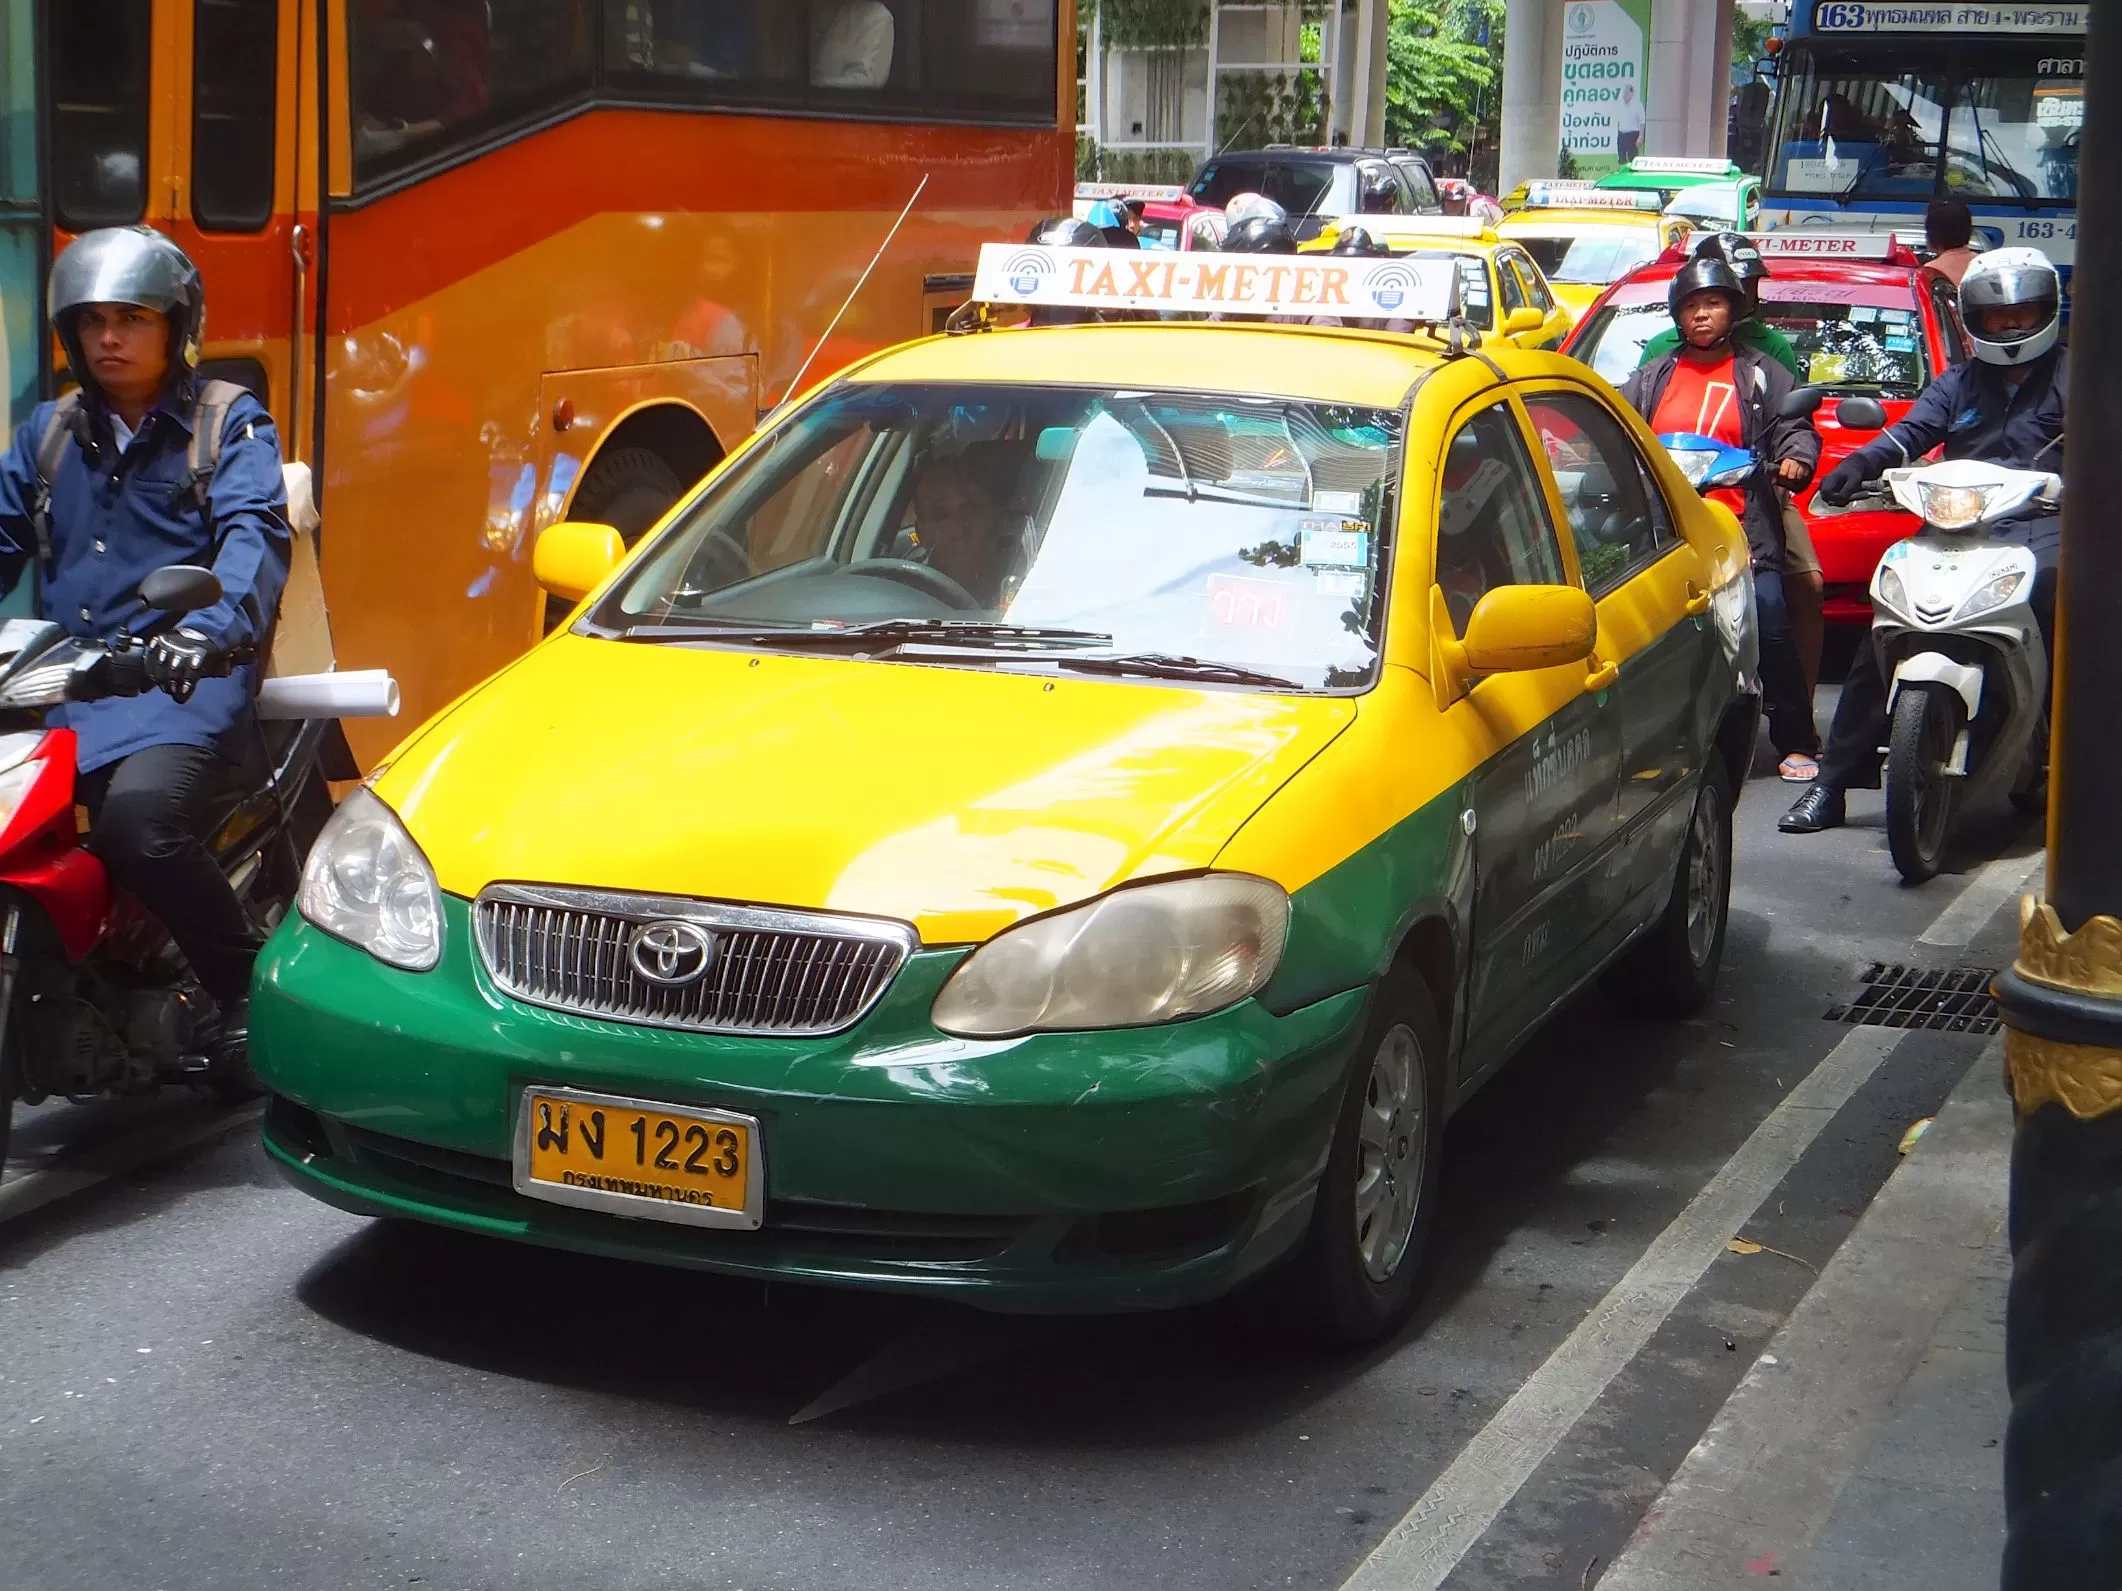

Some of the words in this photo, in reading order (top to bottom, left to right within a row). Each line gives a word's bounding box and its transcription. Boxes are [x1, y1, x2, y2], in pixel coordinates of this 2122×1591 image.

[1818, 4, 1865, 28] 163
[1866, 8, 1951, 31] พุทธมณฑล
[1957, 9, 1989, 26] สาย
[1565, 43, 1618, 60] ปฏิบัติการ
[1564, 61, 1634, 86] ขุดลอก
[1563, 87, 1621, 107] คูคลอง
[1562, 111, 1610, 128] ป้องกัน
[1562, 129, 1610, 149] น้ำท่วม
[1751, 238, 1857, 252] XI-METER
[1068, 258, 1350, 305] TAXI-METER
[629, 1115, 740, 1178] 1223
[562, 1169, 714, 1207] กรงเทพมหานคร
